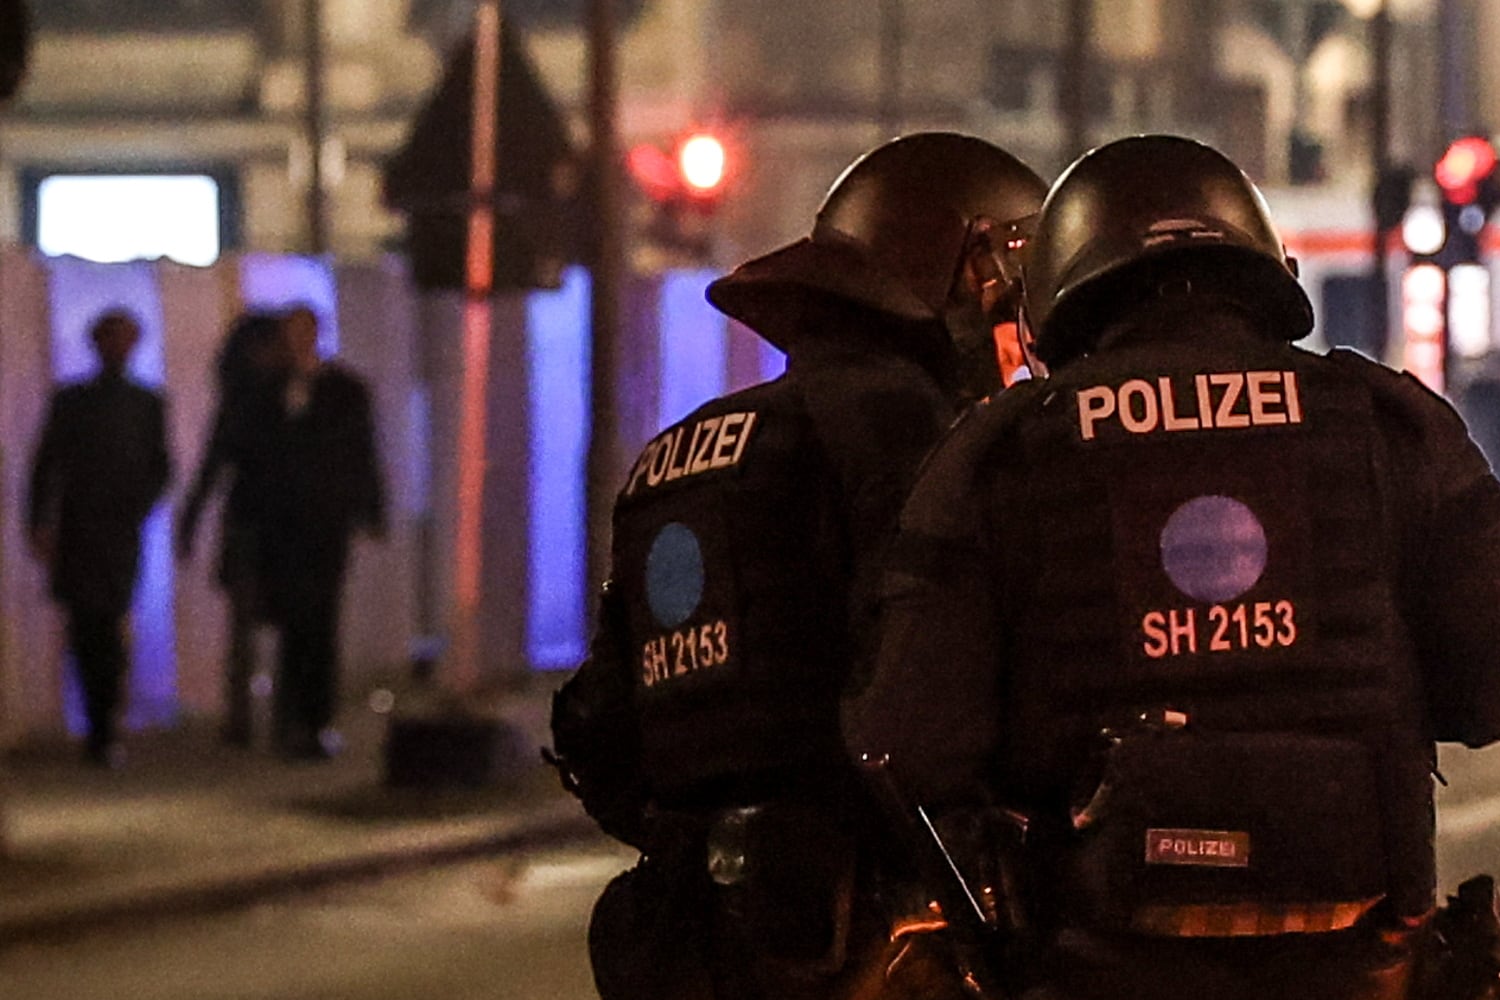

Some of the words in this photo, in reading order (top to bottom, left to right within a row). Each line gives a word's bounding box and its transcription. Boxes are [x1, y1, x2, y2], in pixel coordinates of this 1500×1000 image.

[1077, 371, 1301, 440] POLIZEI
[627, 412, 757, 496] POLIZEI
[643, 636, 669, 686] SH
[672, 620, 729, 674] 2153
[1142, 608, 1196, 657] SH
[1208, 601, 1296, 651] 2153
[1159, 838, 1235, 857] POLIZEI
